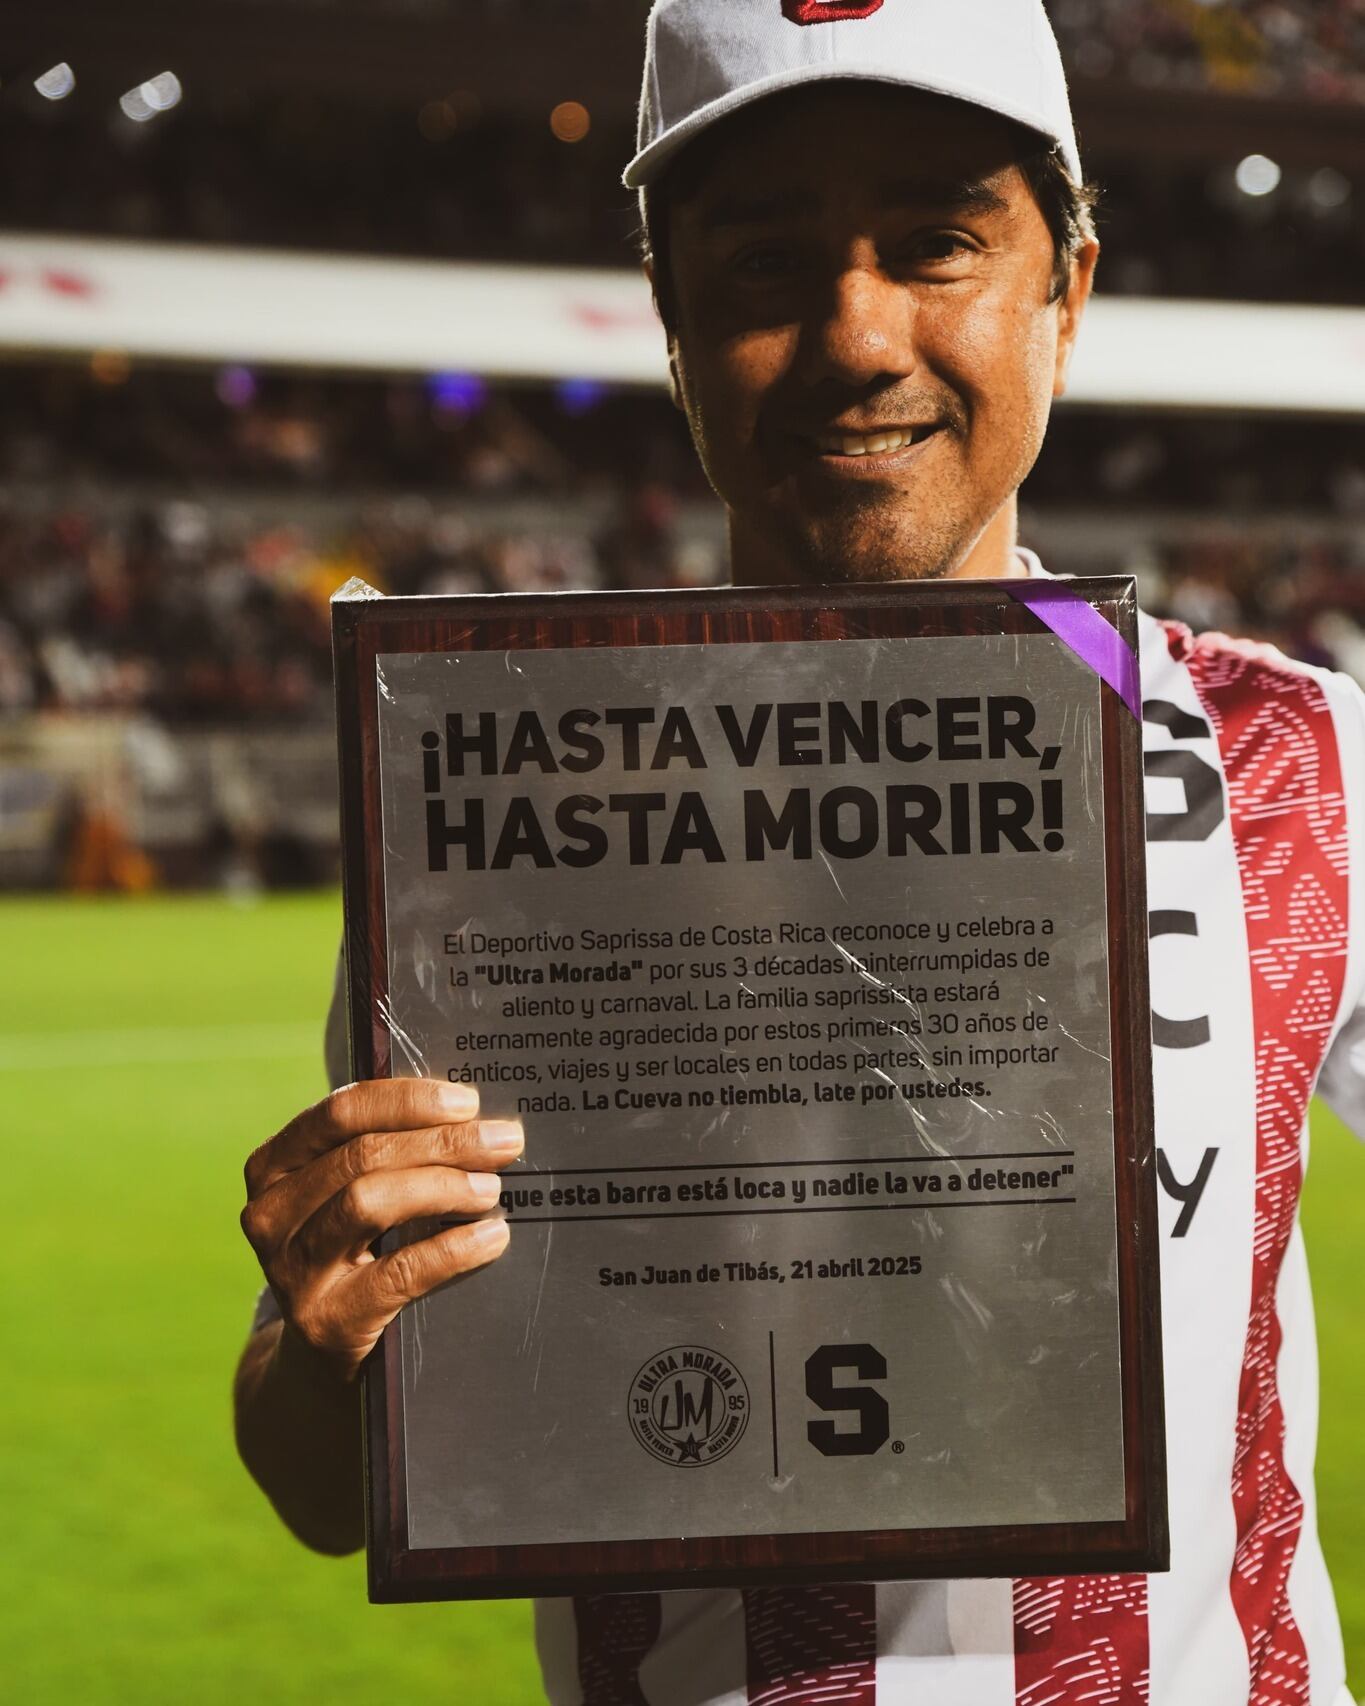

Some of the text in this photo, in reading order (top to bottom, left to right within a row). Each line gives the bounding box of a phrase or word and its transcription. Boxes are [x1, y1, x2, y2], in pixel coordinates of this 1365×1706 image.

[421, 695, 1062, 793] ¡HASTA VENCER,
[426, 779, 1064, 872] HASTA MORIR!
[443, 916, 1053, 957] El Deportivo Saprissa de Costa Rica reconoce y celebra a
[451, 947, 1050, 987] la "Ultra Morada" por sus 3 décadas ininterrumpidas de
[502, 981, 1000, 1019] aliento y carnaval. La familia saprissista estará
[456, 1011, 1049, 1050] eternamente agradecida por estos primeros 30 años de
[447, 1044, 1059, 1084] cánticos, viajes y ser locales en todas partes, sin importar
[517, 1077, 992, 1113] nada. La Cueva no tiembla, late por ustedes.
[550, 1184, 600, 1207] esta
[606, 1182, 671, 1204] barra
[677, 1177, 729, 1202] está
[734, 1177, 786, 1200] loca
[791, 1180, 806, 1203] y
[812, 1172, 879, 1196] nadie
[885, 1171, 908, 1194] la
[912, 1174, 942, 1193] va
[947, 1173, 962, 1191] a
[967, 1164, 1074, 1191] detener"
[598, 1255, 923, 1286] San Juan de Tibás, 21 abril 2025
[637, 1352, 737, 1392] ULTRA MORADA
[633, 1398, 649, 1414] 19
[728, 1395, 745, 1411] 95
[804, 1343, 890, 1457] S
